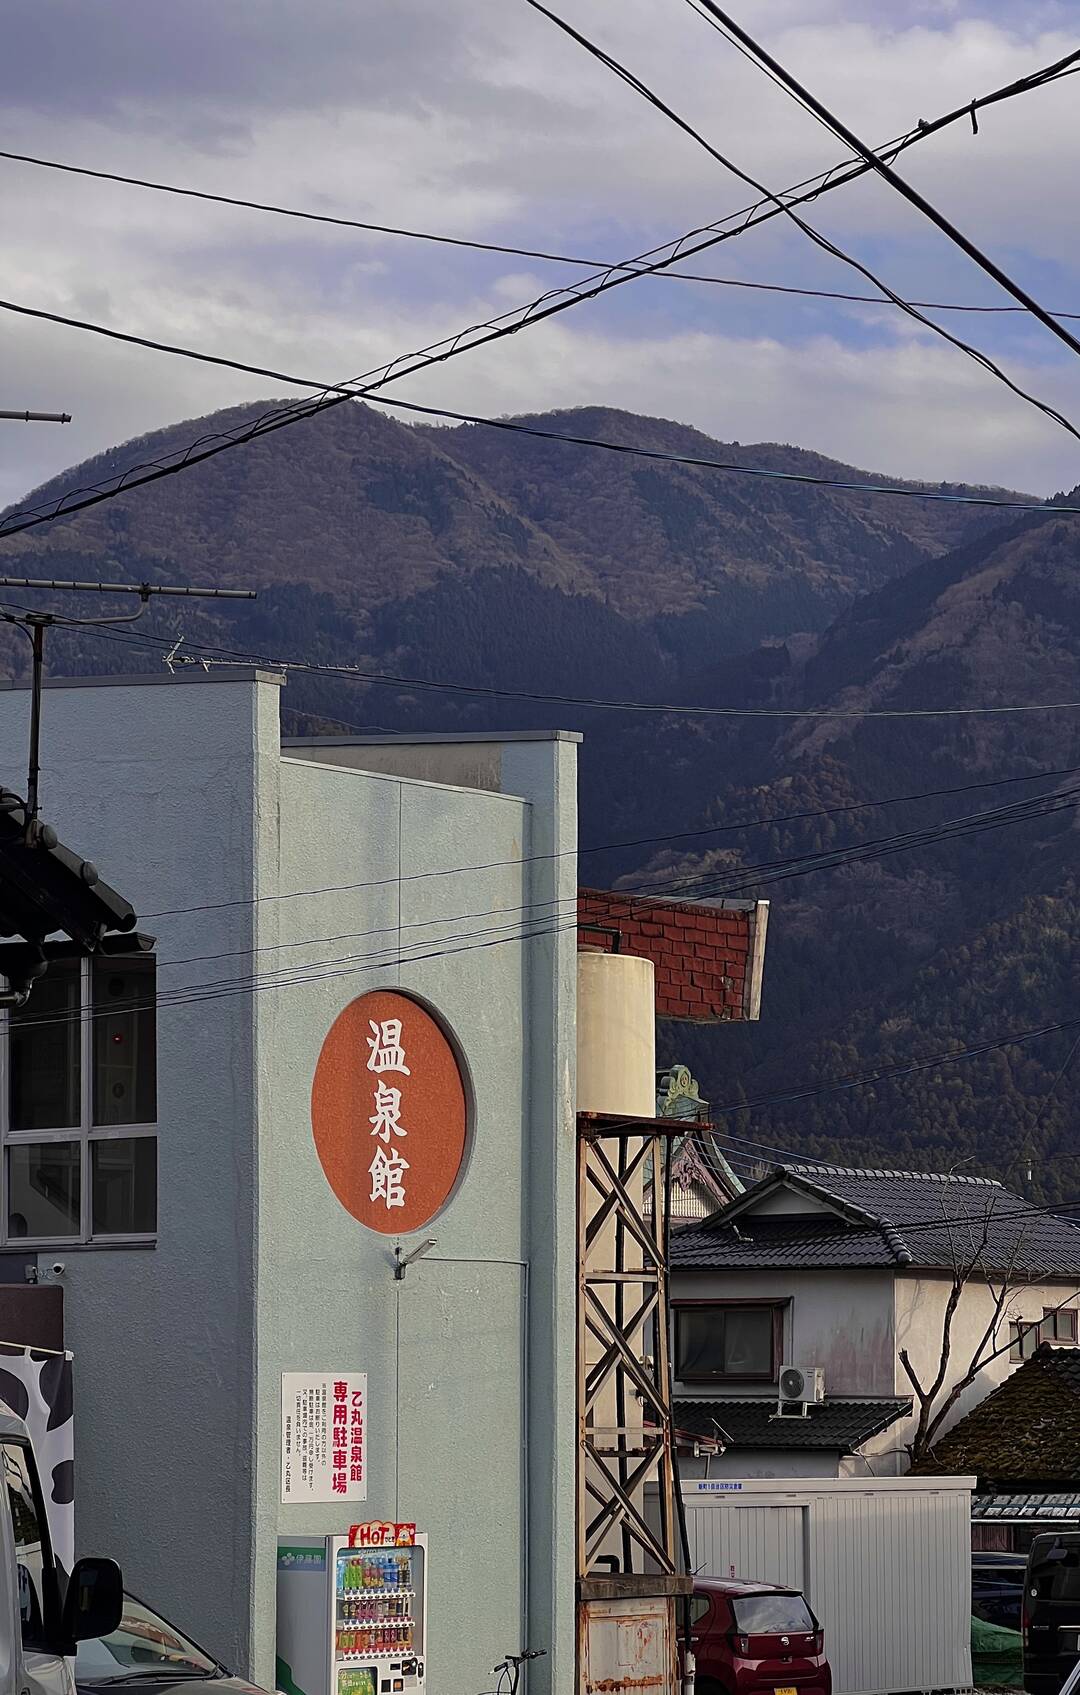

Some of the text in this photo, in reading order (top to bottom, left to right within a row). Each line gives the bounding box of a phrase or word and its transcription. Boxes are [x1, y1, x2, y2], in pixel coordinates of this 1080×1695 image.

[366, 1018, 411, 1210] 温泉館
[333, 1381, 347, 1493] 専用駐車場
[350, 1391, 362, 1481] 乙丸温泉館
[360, 1526, 389, 1545] HOT
